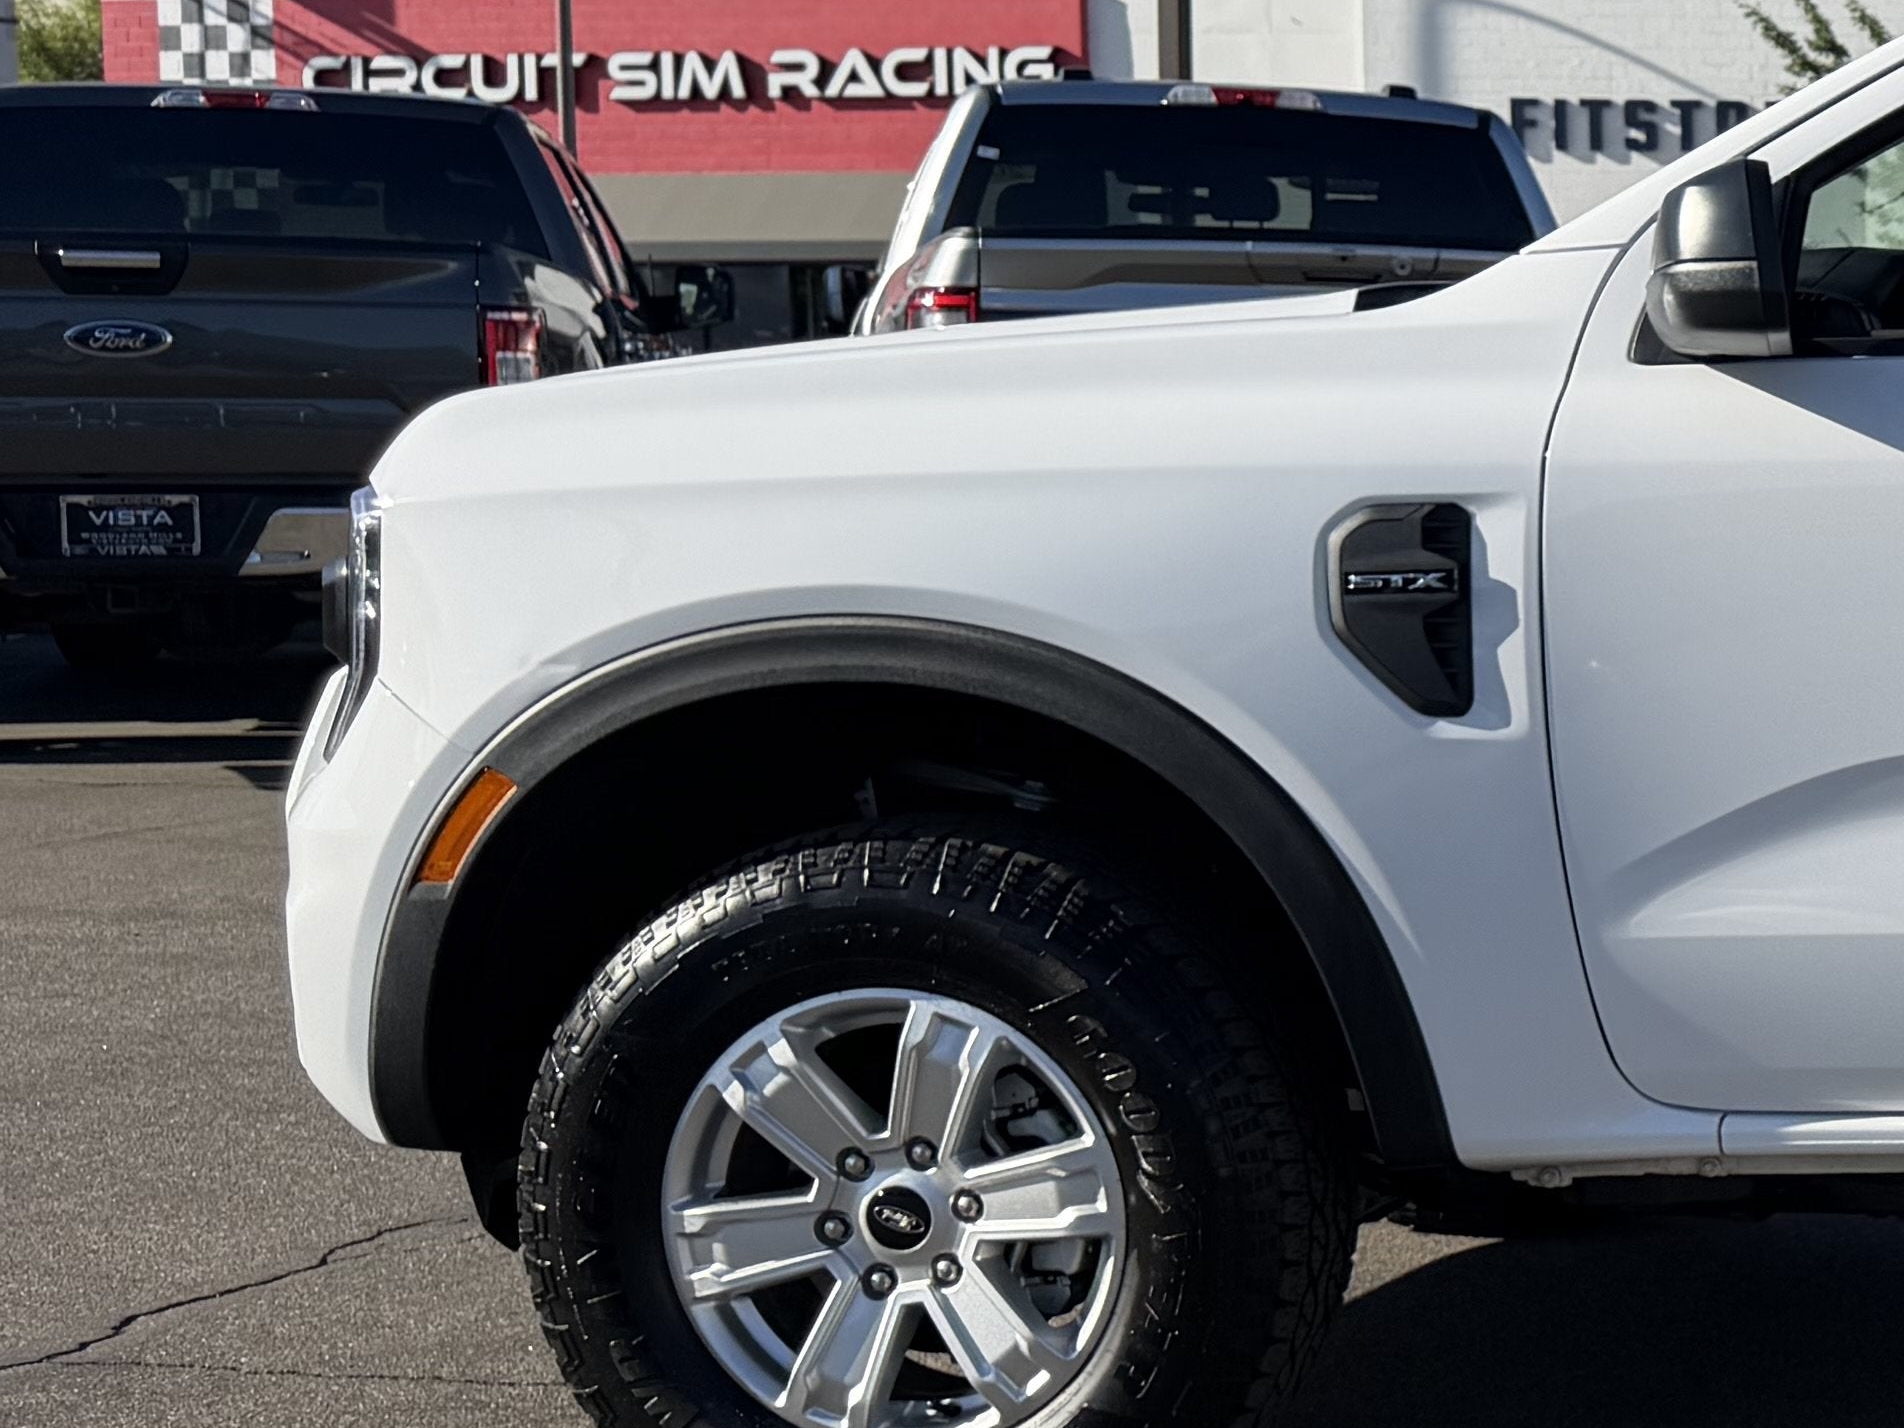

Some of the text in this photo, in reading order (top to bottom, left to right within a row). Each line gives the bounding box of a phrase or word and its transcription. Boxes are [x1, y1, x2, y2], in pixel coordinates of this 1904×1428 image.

[607, 50, 747, 101] SIM
[767, 47, 1058, 99] RACING
[1510, 98, 1781, 151] FITSTO
[88, 326, 147, 350] Ford
[88, 509, 174, 527] VISTA
[1347, 572, 1449, 589] STX
